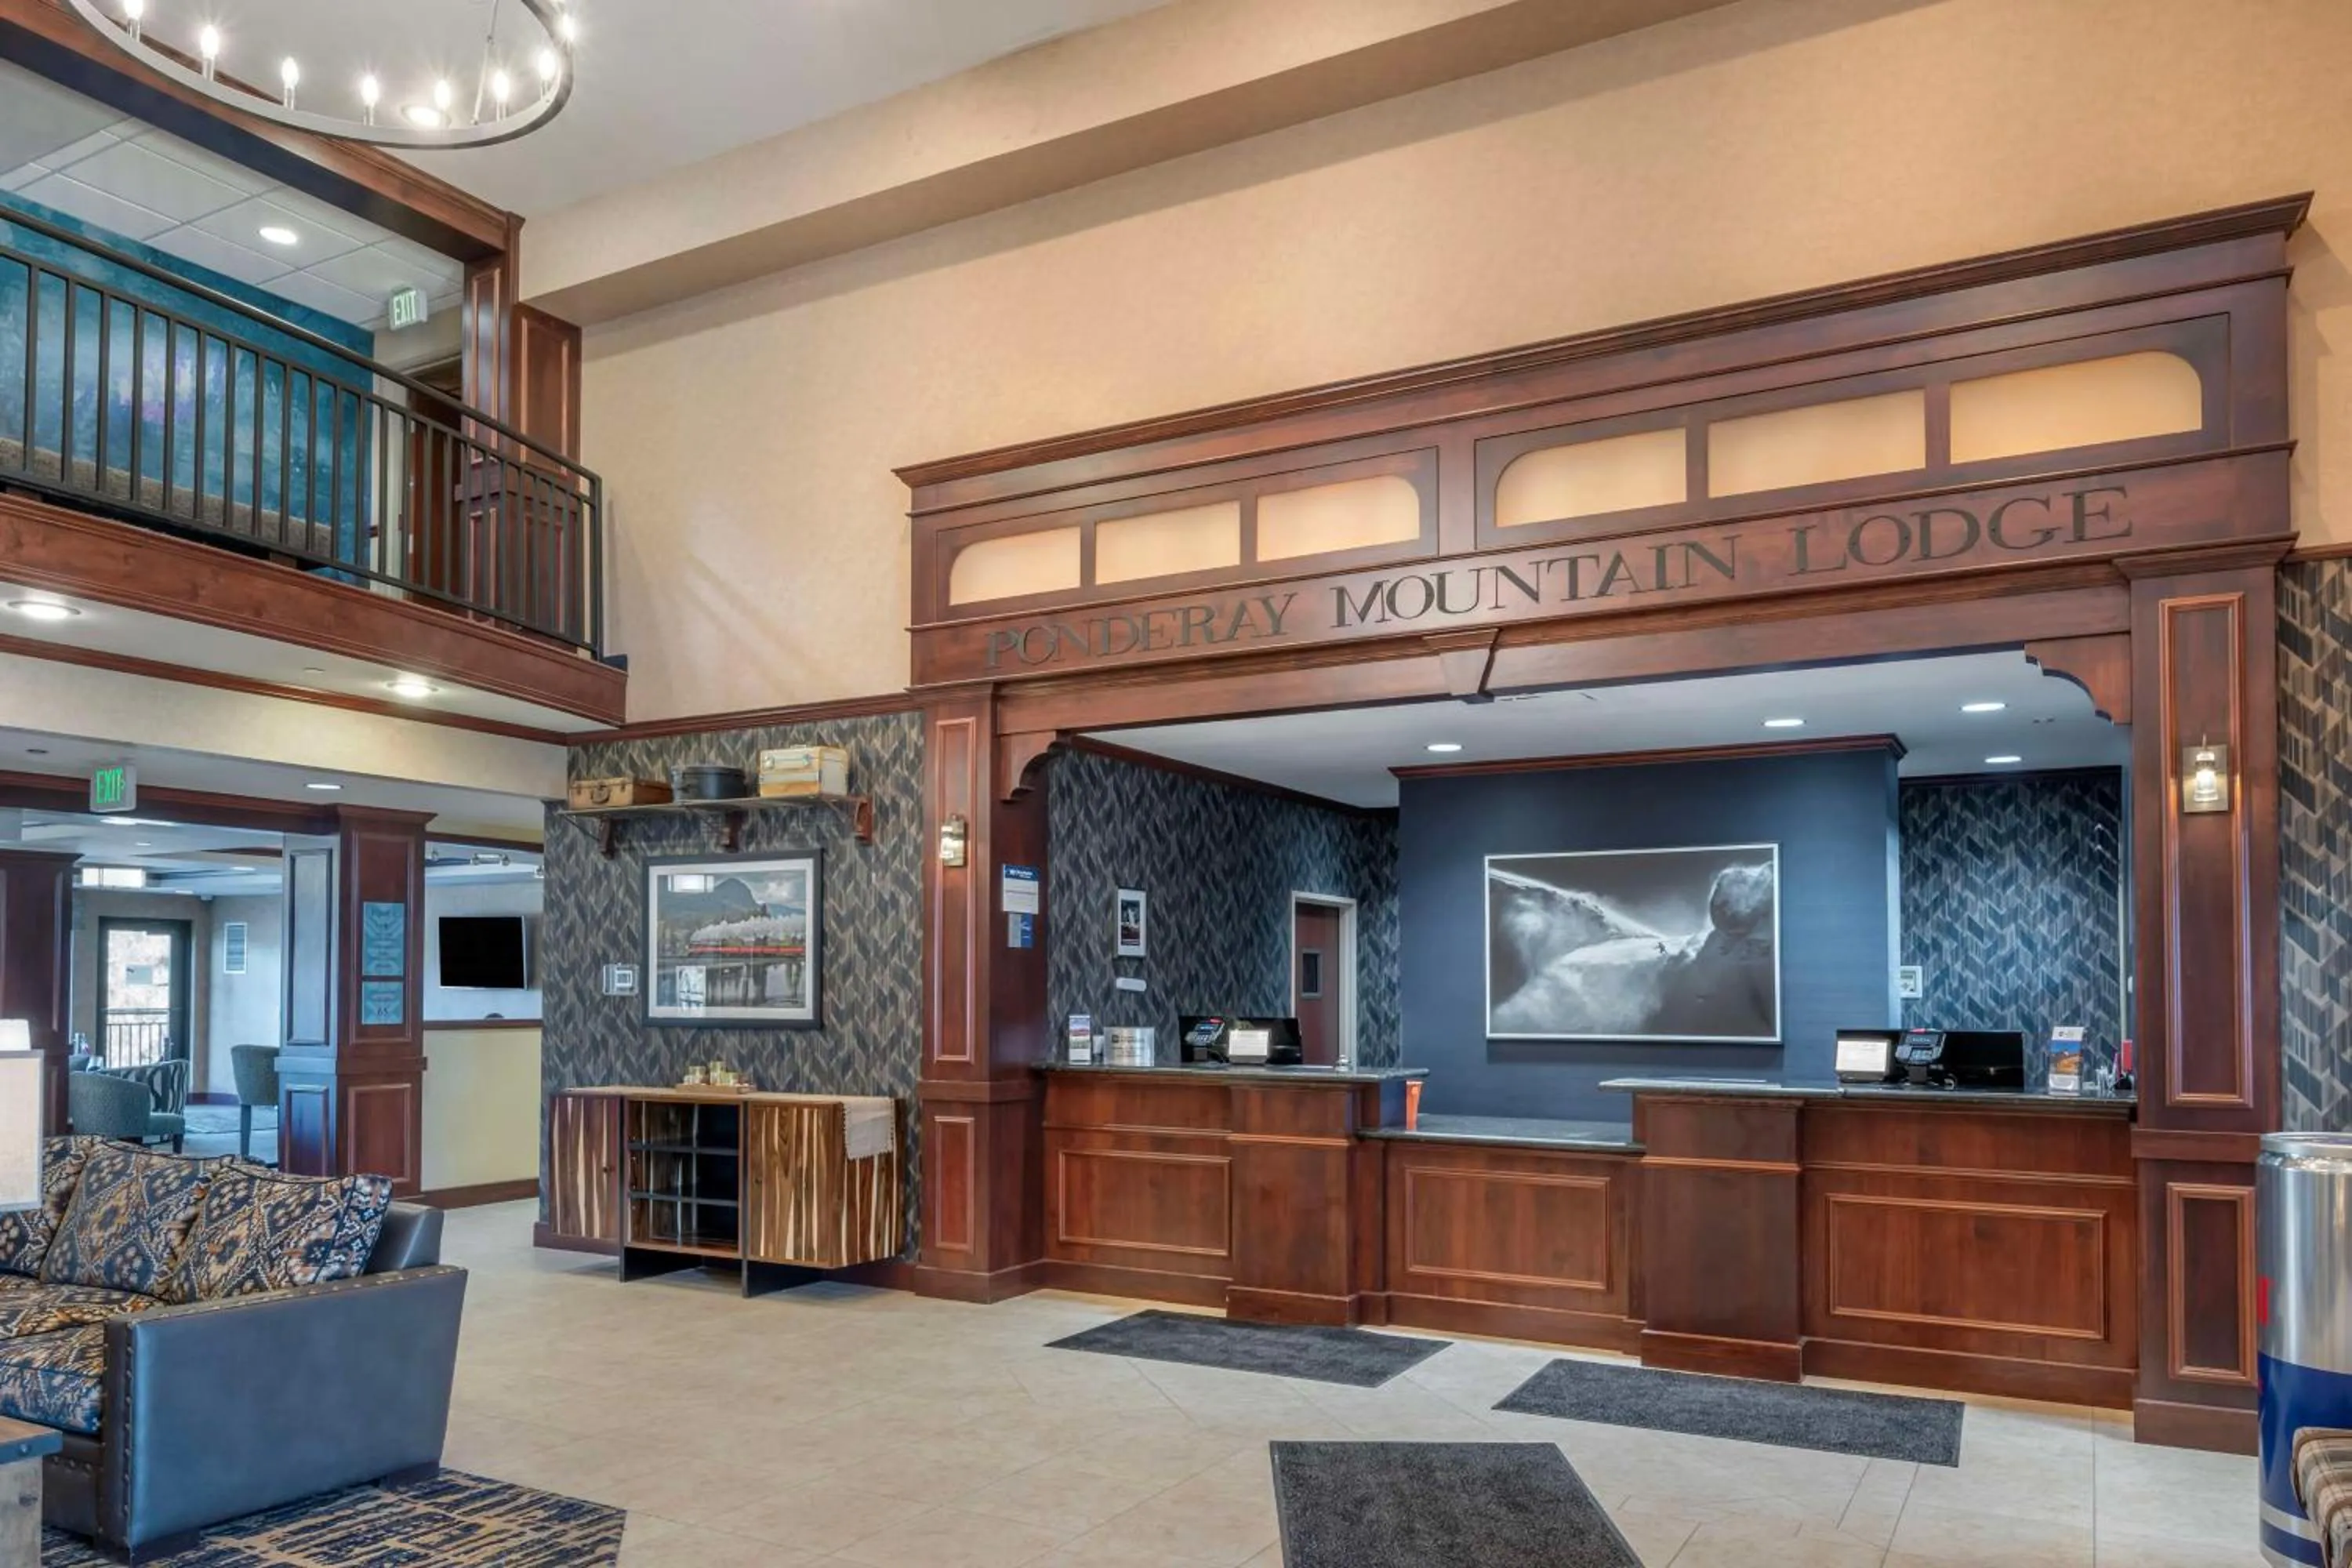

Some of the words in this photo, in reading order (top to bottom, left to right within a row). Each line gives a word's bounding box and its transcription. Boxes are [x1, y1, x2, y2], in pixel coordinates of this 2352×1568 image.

[393, 289, 416, 326] EXIT
[984, 593, 1295, 670] PONDERAY
[1330, 534, 1741, 629] MOUNTAIN
[1784, 485, 2132, 576] LODGE
[96, 768, 122, 804] EXIT
